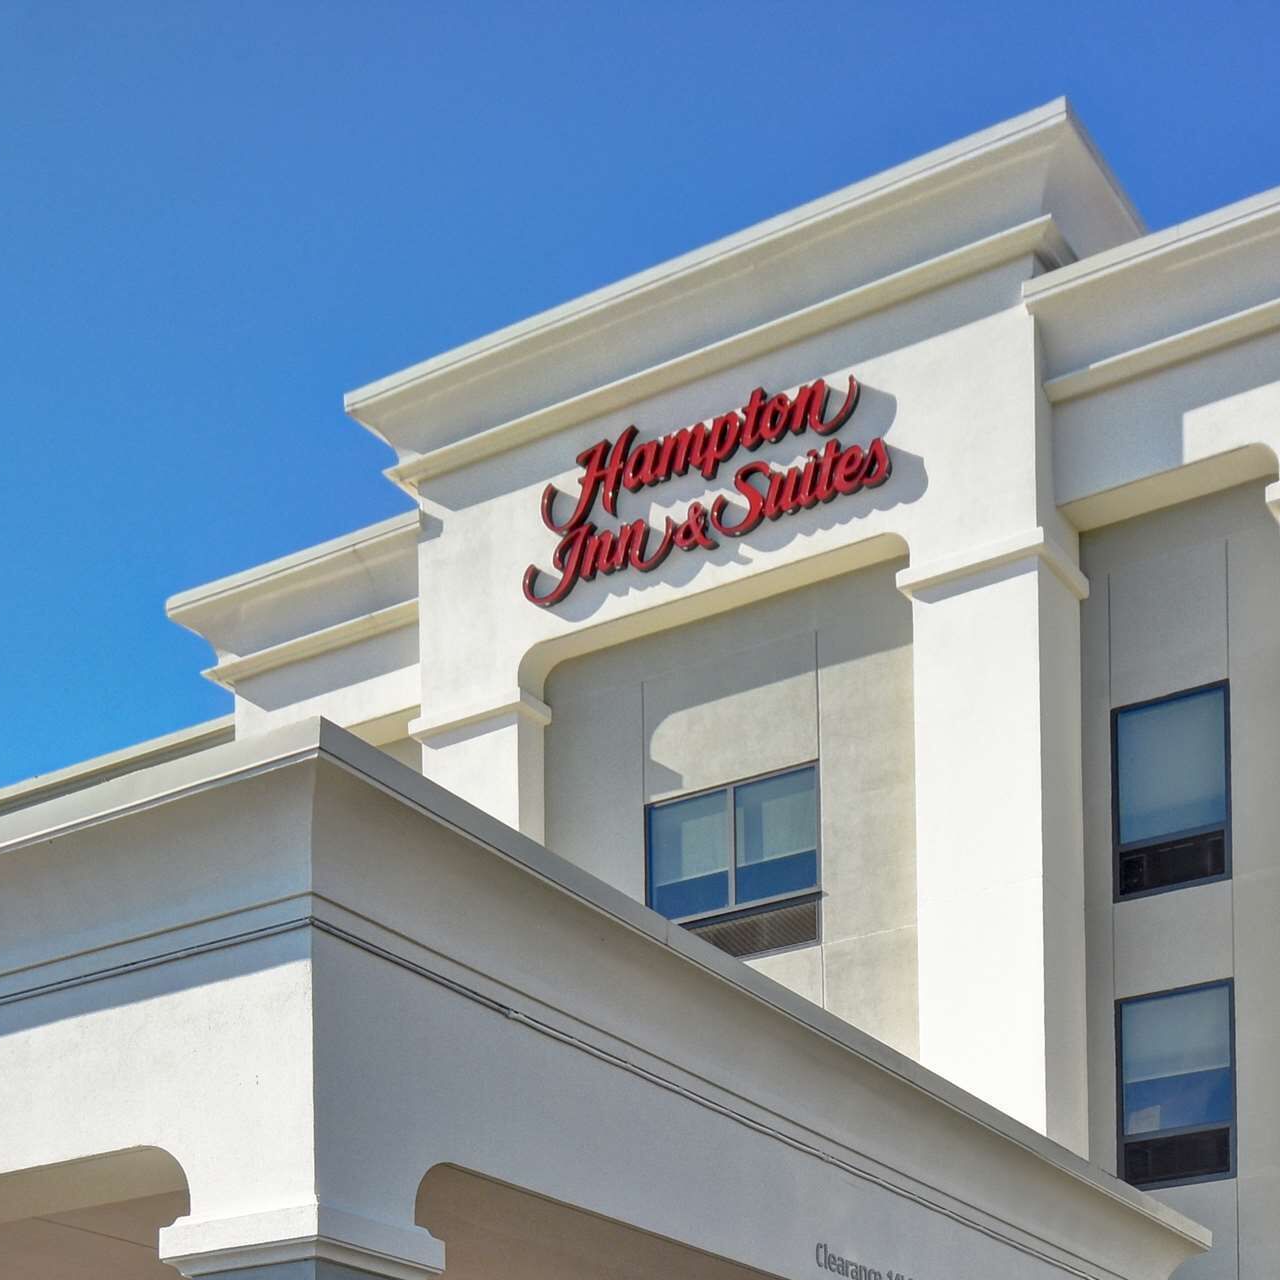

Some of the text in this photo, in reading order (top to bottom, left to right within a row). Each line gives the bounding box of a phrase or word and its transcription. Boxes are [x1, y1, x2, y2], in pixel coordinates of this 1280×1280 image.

[523, 437, 893, 607] Inn & Suites
[541, 374, 861, 534] Hampton
